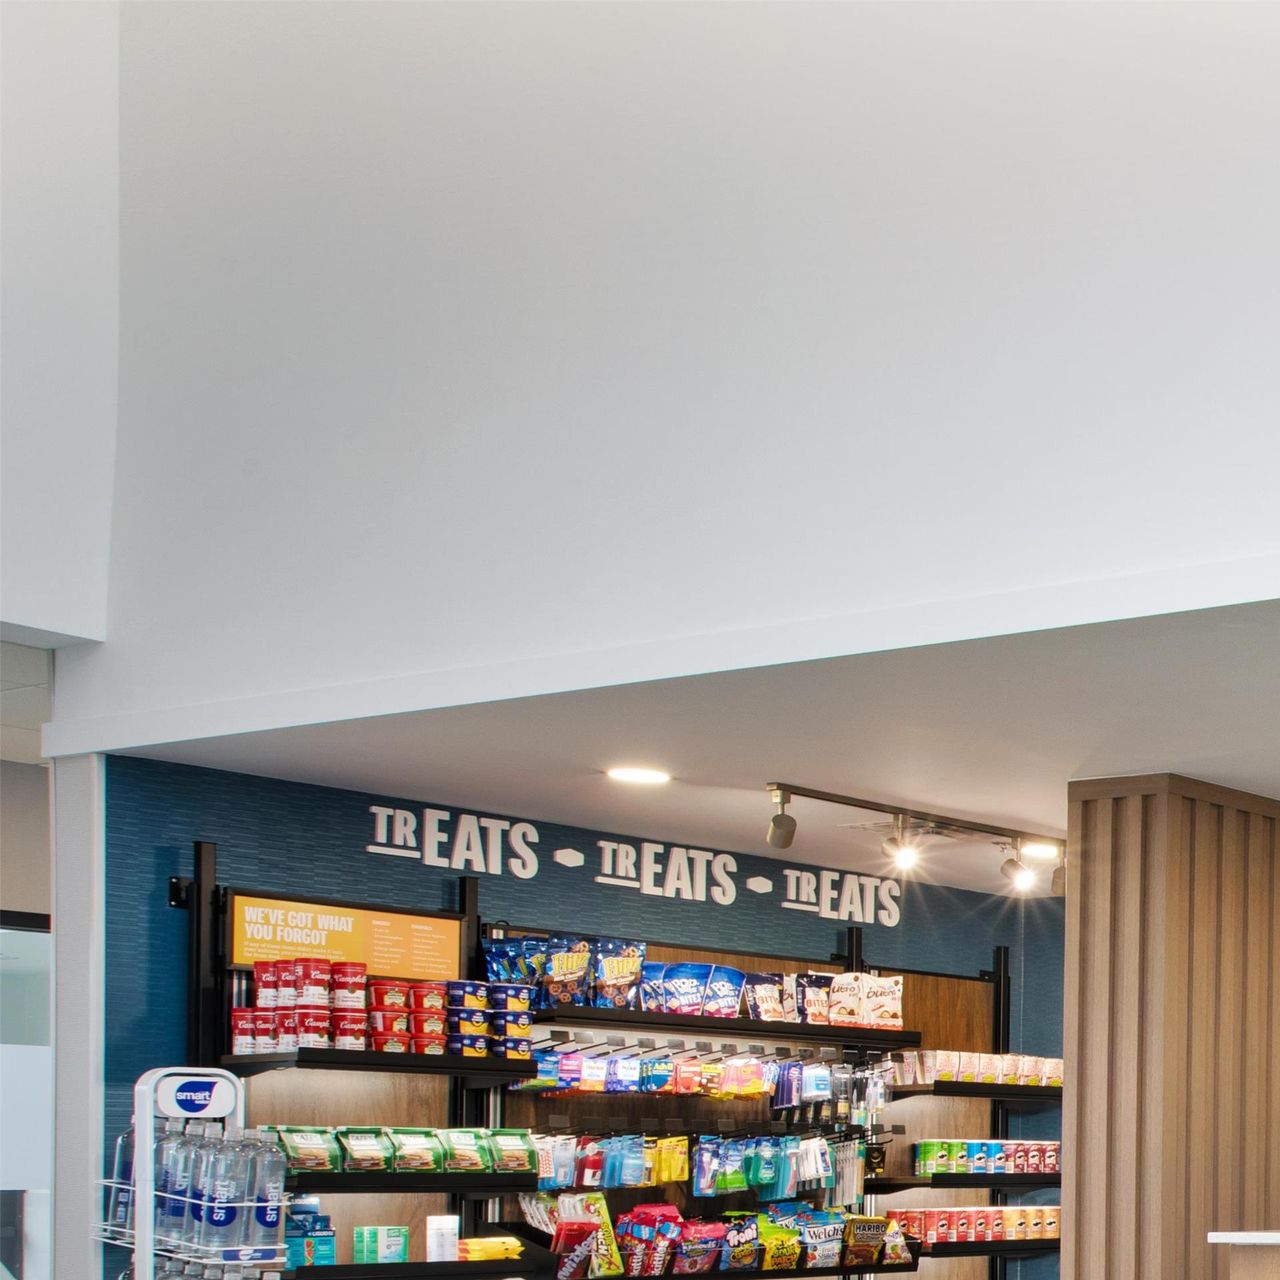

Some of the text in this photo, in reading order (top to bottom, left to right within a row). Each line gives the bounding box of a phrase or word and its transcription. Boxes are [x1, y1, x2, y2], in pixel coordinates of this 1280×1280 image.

[366, 805, 901, 928] TREATS TREATS TREATS
[243, 905, 354, 933] WE'VE GOT WHAT
[244, 923, 329, 946] YOU FORGOT
[176, 1091, 211, 1100] smart
[808, 1225, 844, 1241] Welch's
[855, 1223, 887, 1233] HARIBO
